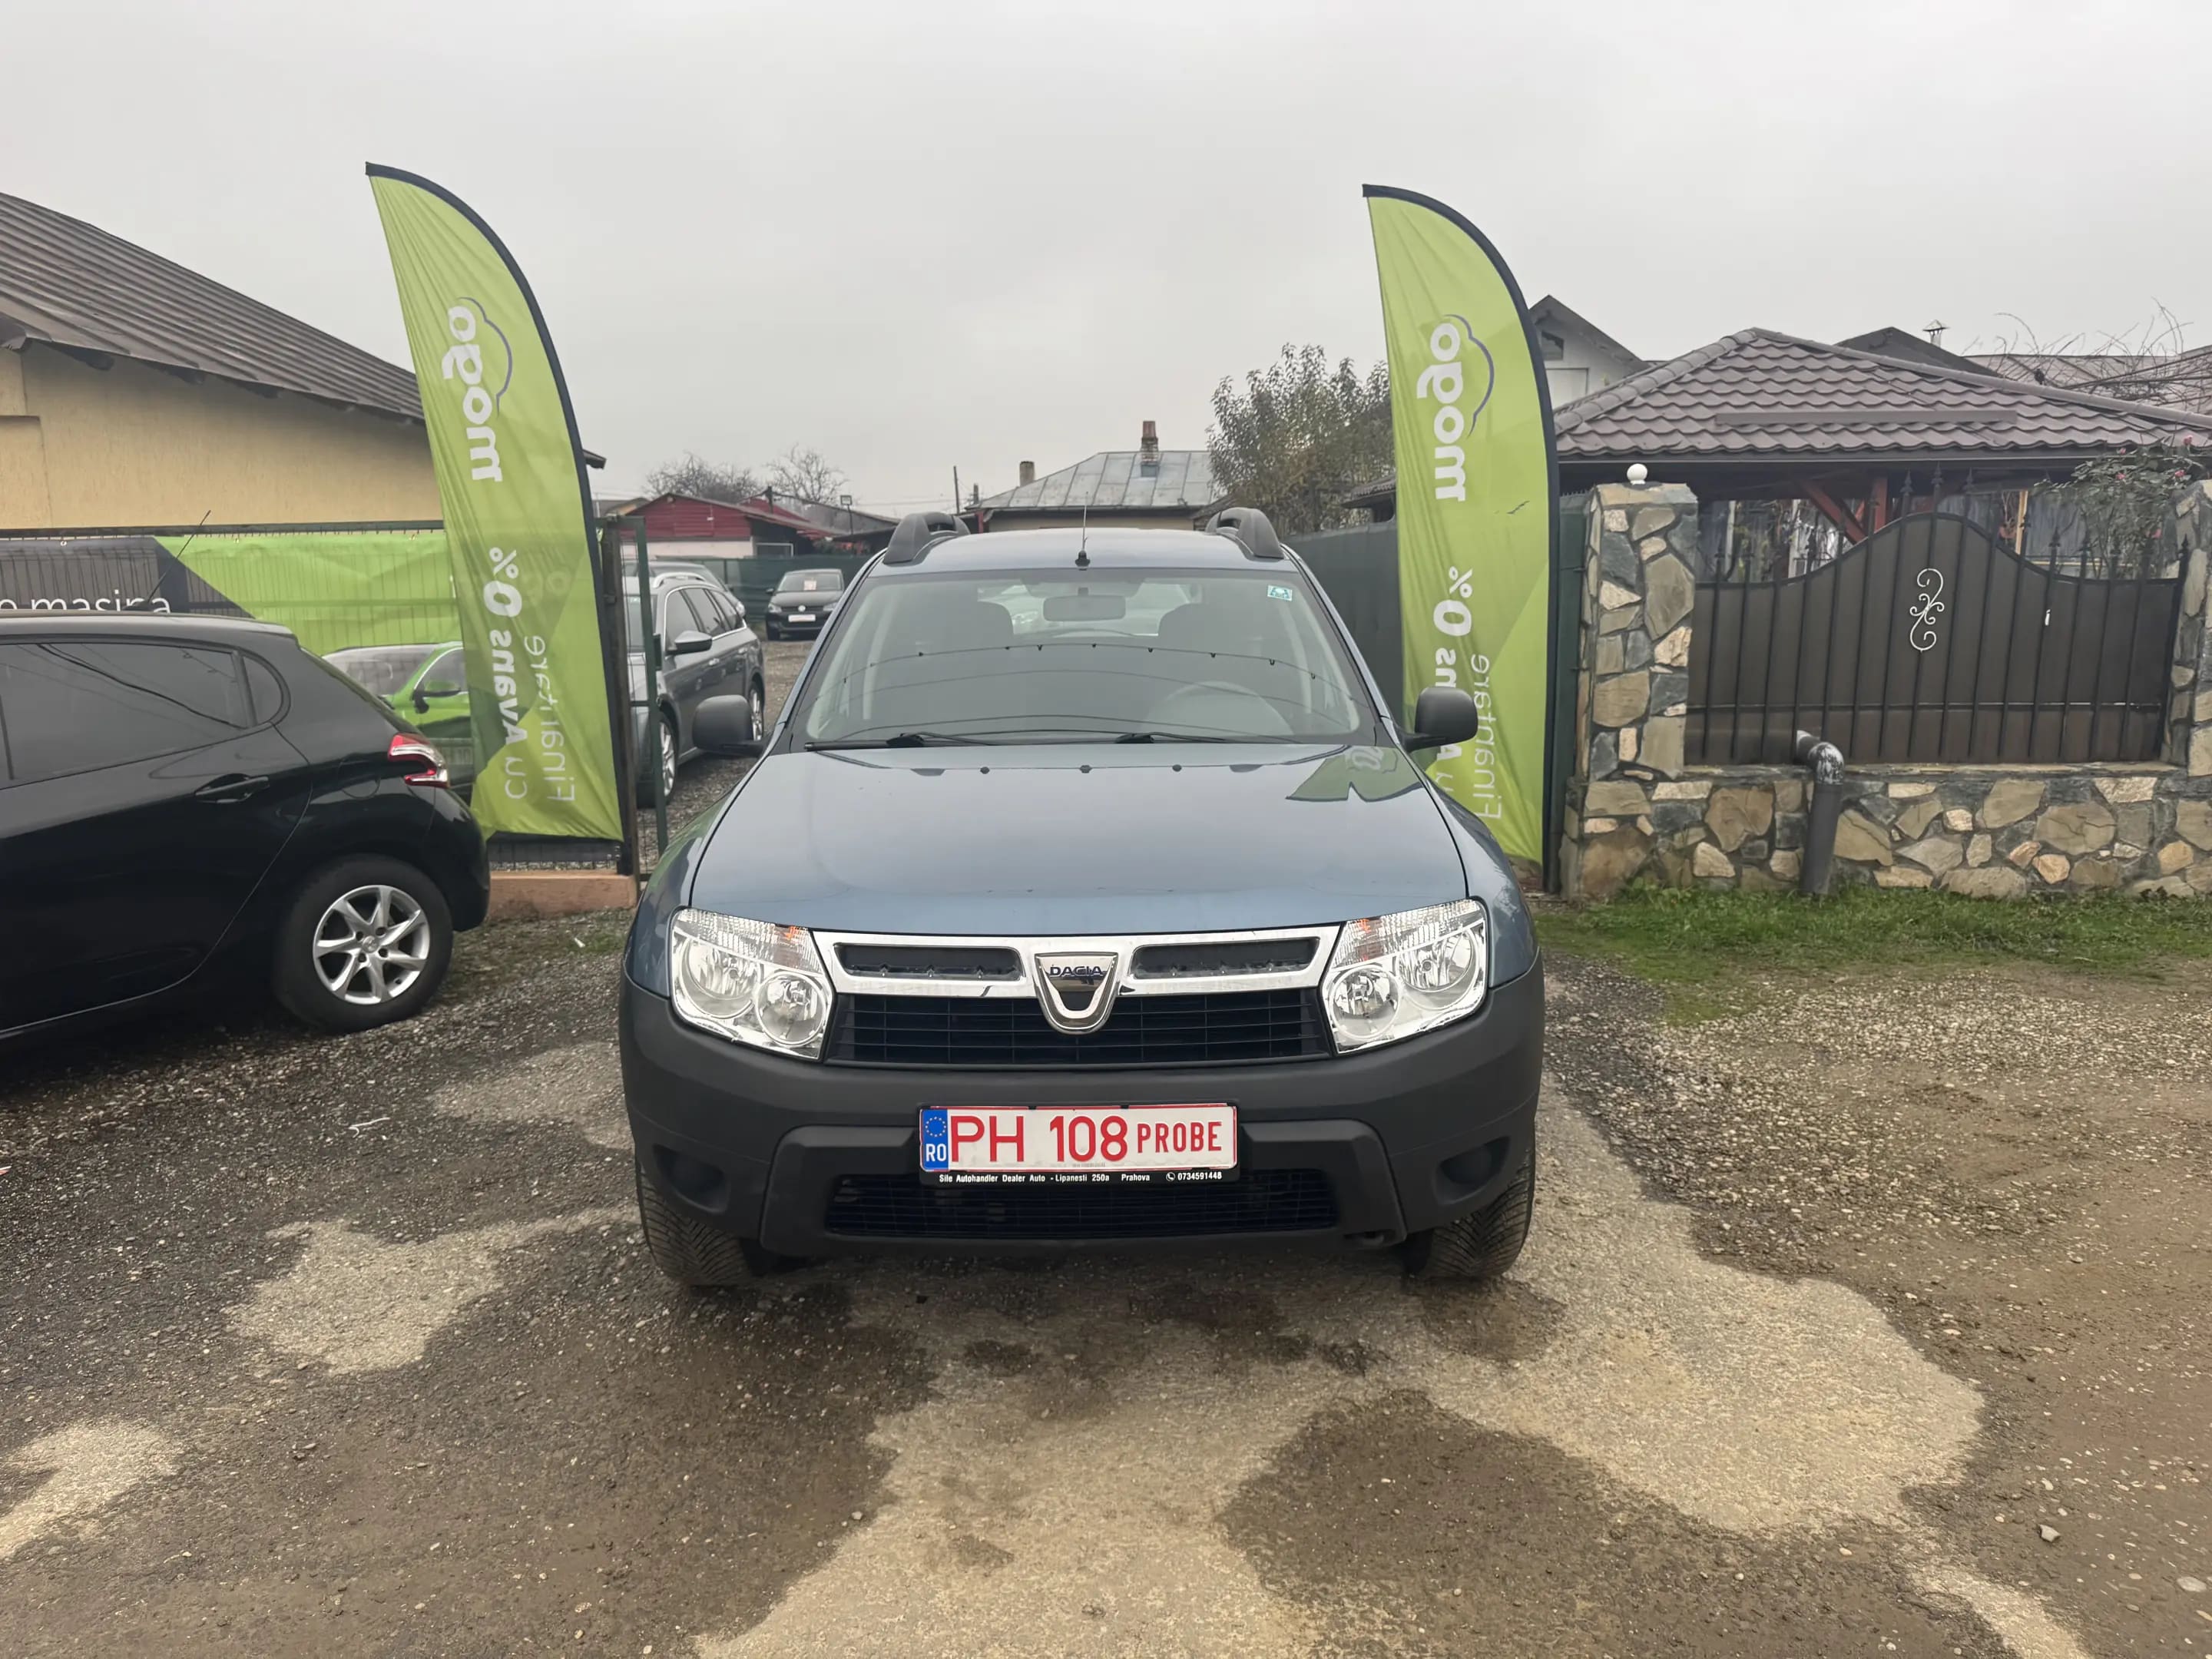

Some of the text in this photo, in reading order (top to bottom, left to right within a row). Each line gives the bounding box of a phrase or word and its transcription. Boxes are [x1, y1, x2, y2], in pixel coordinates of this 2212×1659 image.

[1050, 965, 1104, 977] DACIA
[950, 1115, 1223, 1162] PH 108 PROBE
[926, 1144, 946, 1162] RO
[939, 1174, 953, 1183] Sile
[956, 1174, 998, 1183] Autohandler
[1002, 1174, 1025, 1183] Dealer
[1029, 1174, 1045, 1183] Auto
[1091, 1174, 1110, 1182] 250a
[1121, 1173, 1151, 1181] Prahova
